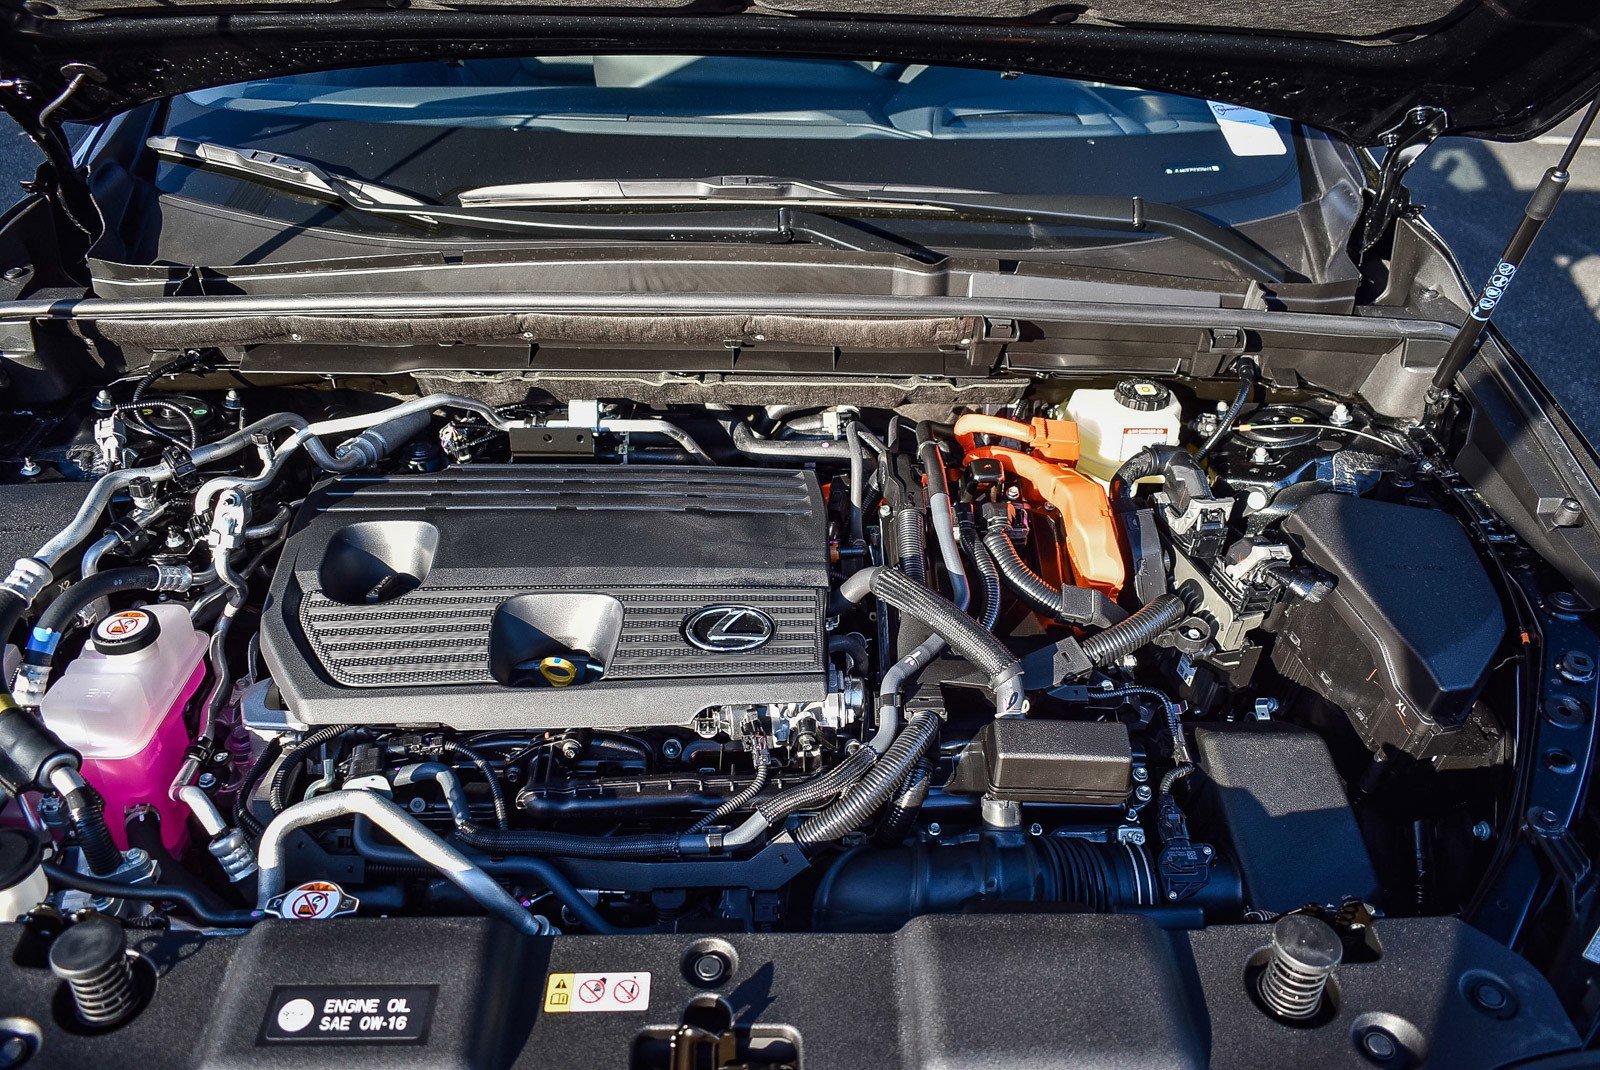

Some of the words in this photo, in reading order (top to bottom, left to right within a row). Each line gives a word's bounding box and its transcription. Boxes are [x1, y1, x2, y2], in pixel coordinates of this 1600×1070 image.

[323, 998, 380, 1013] ENGINE
[386, 998, 411, 1013] OIL
[318, 1016, 353, 1031] SAE
